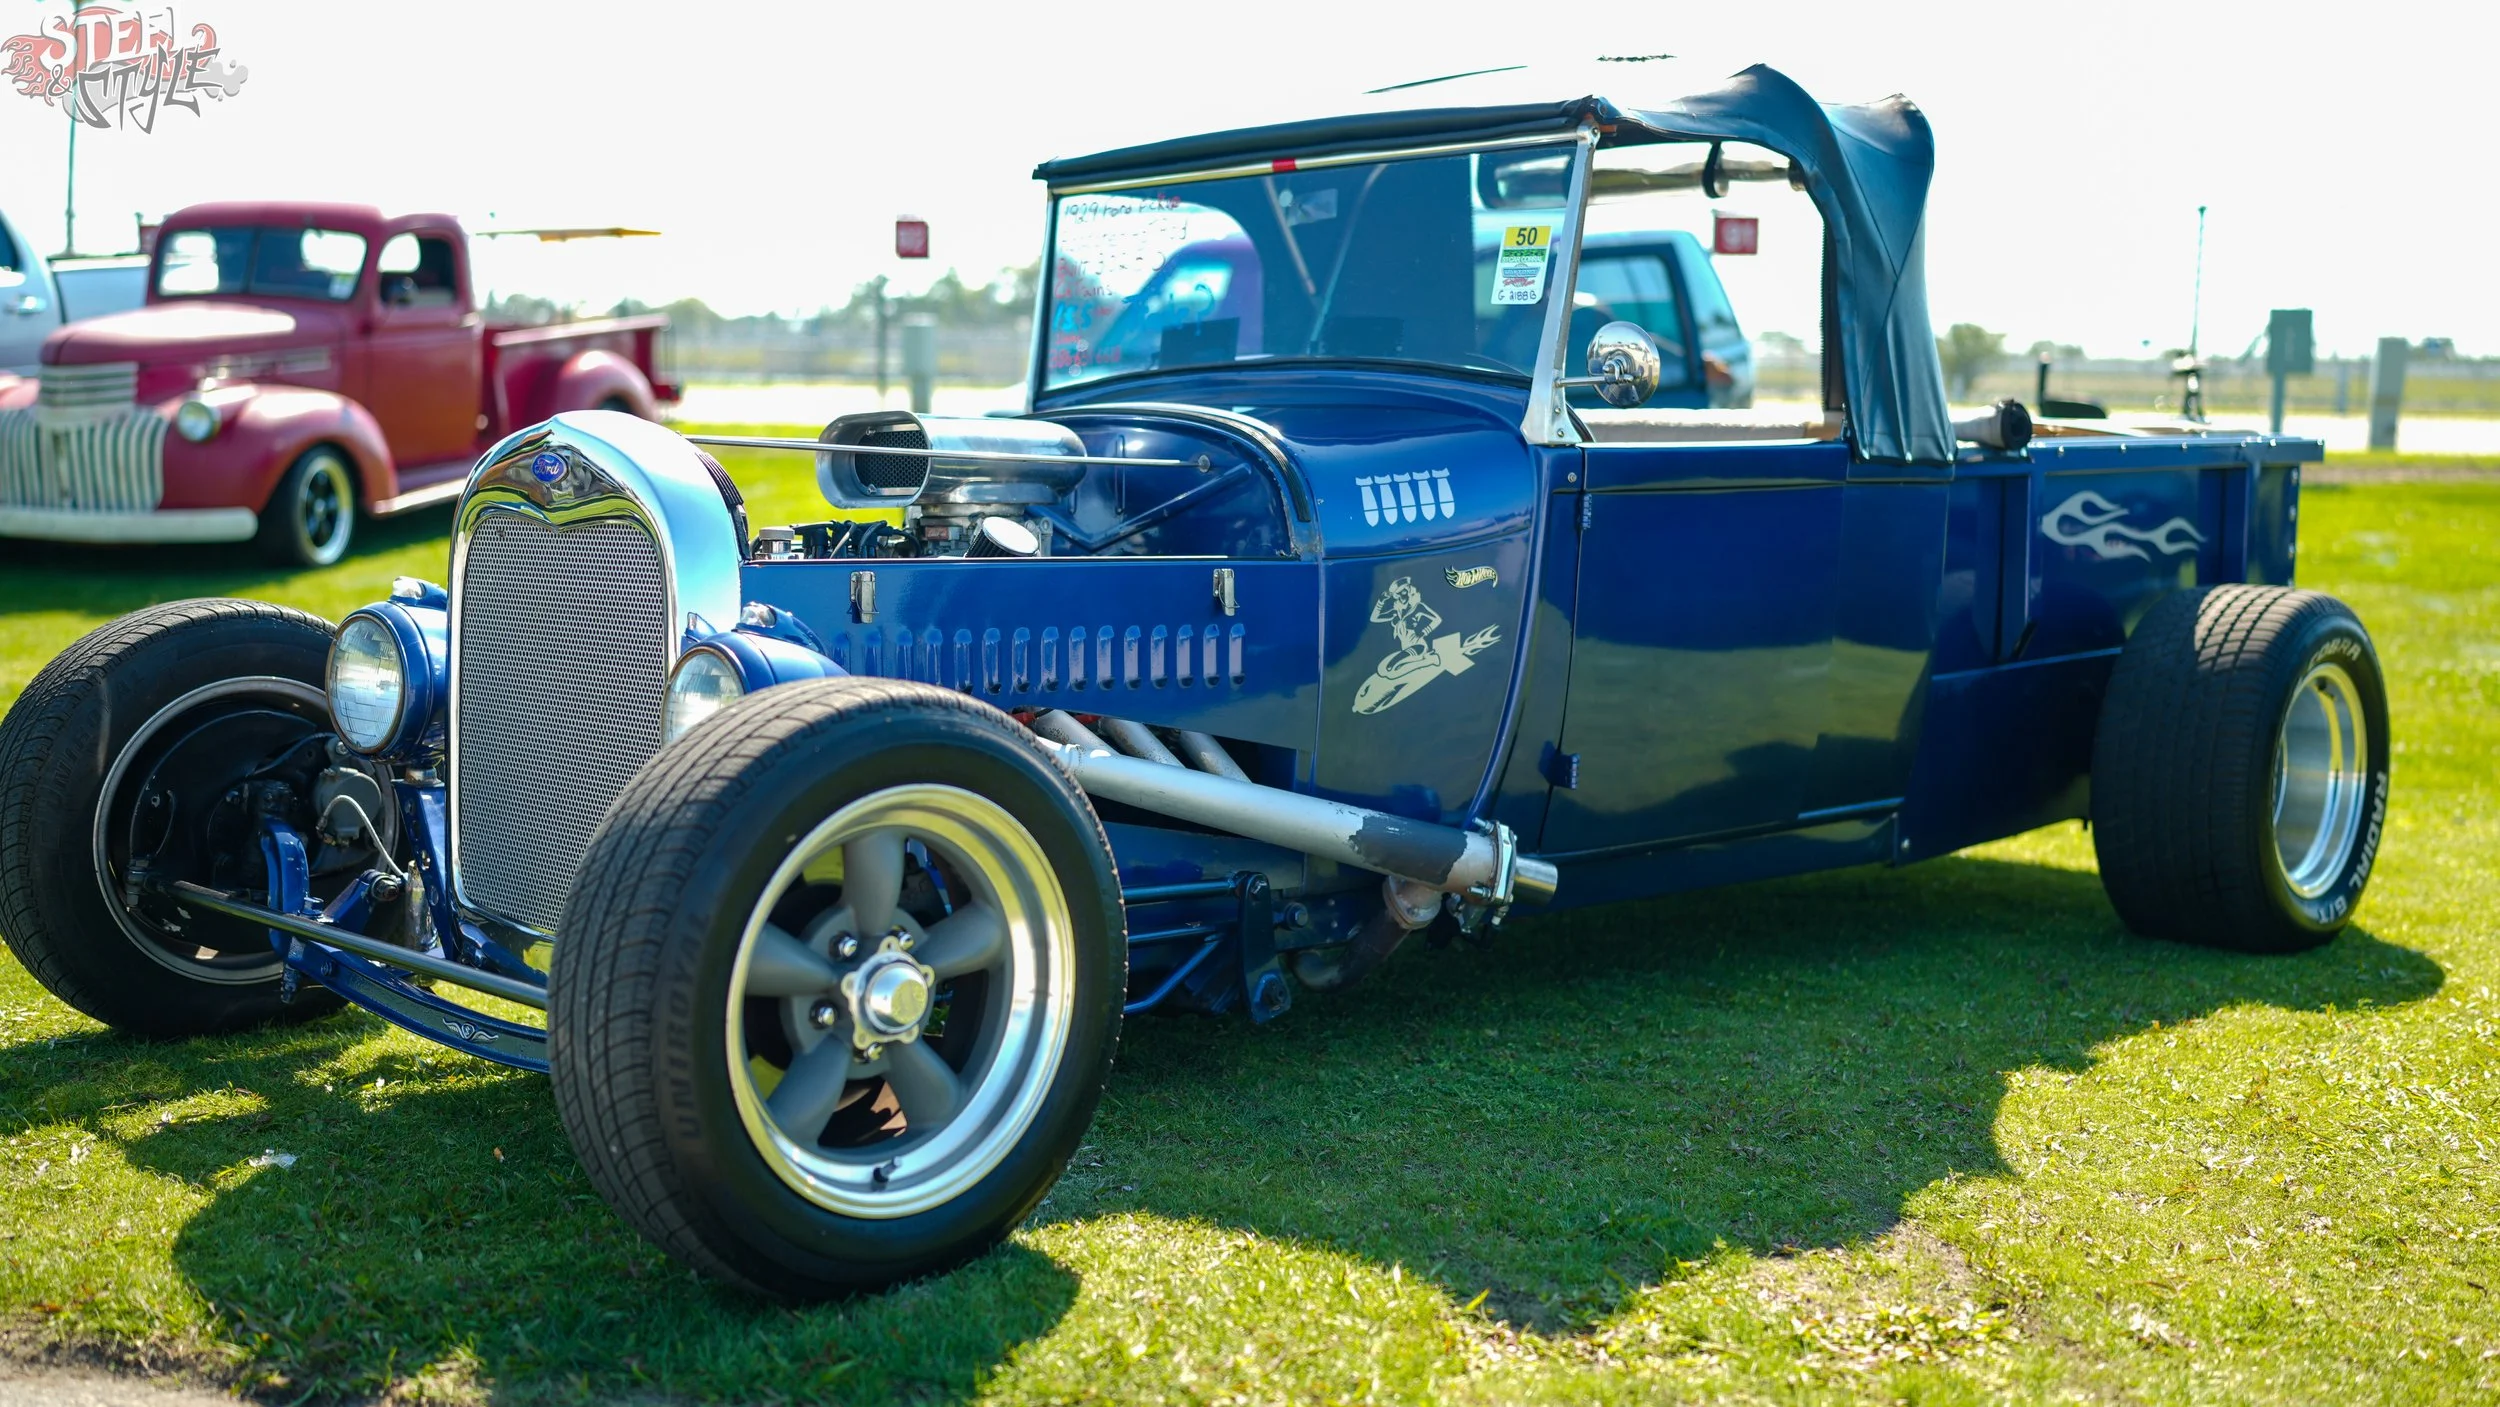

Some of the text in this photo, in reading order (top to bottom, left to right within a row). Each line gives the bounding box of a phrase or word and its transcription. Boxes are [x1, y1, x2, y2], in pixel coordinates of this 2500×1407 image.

[1515, 226, 1538, 246] 50
[534, 457, 560, 476] Ford
[2308, 637, 2363, 669] COBRA
[2316, 770, 2388, 925] RADIAL G/T
